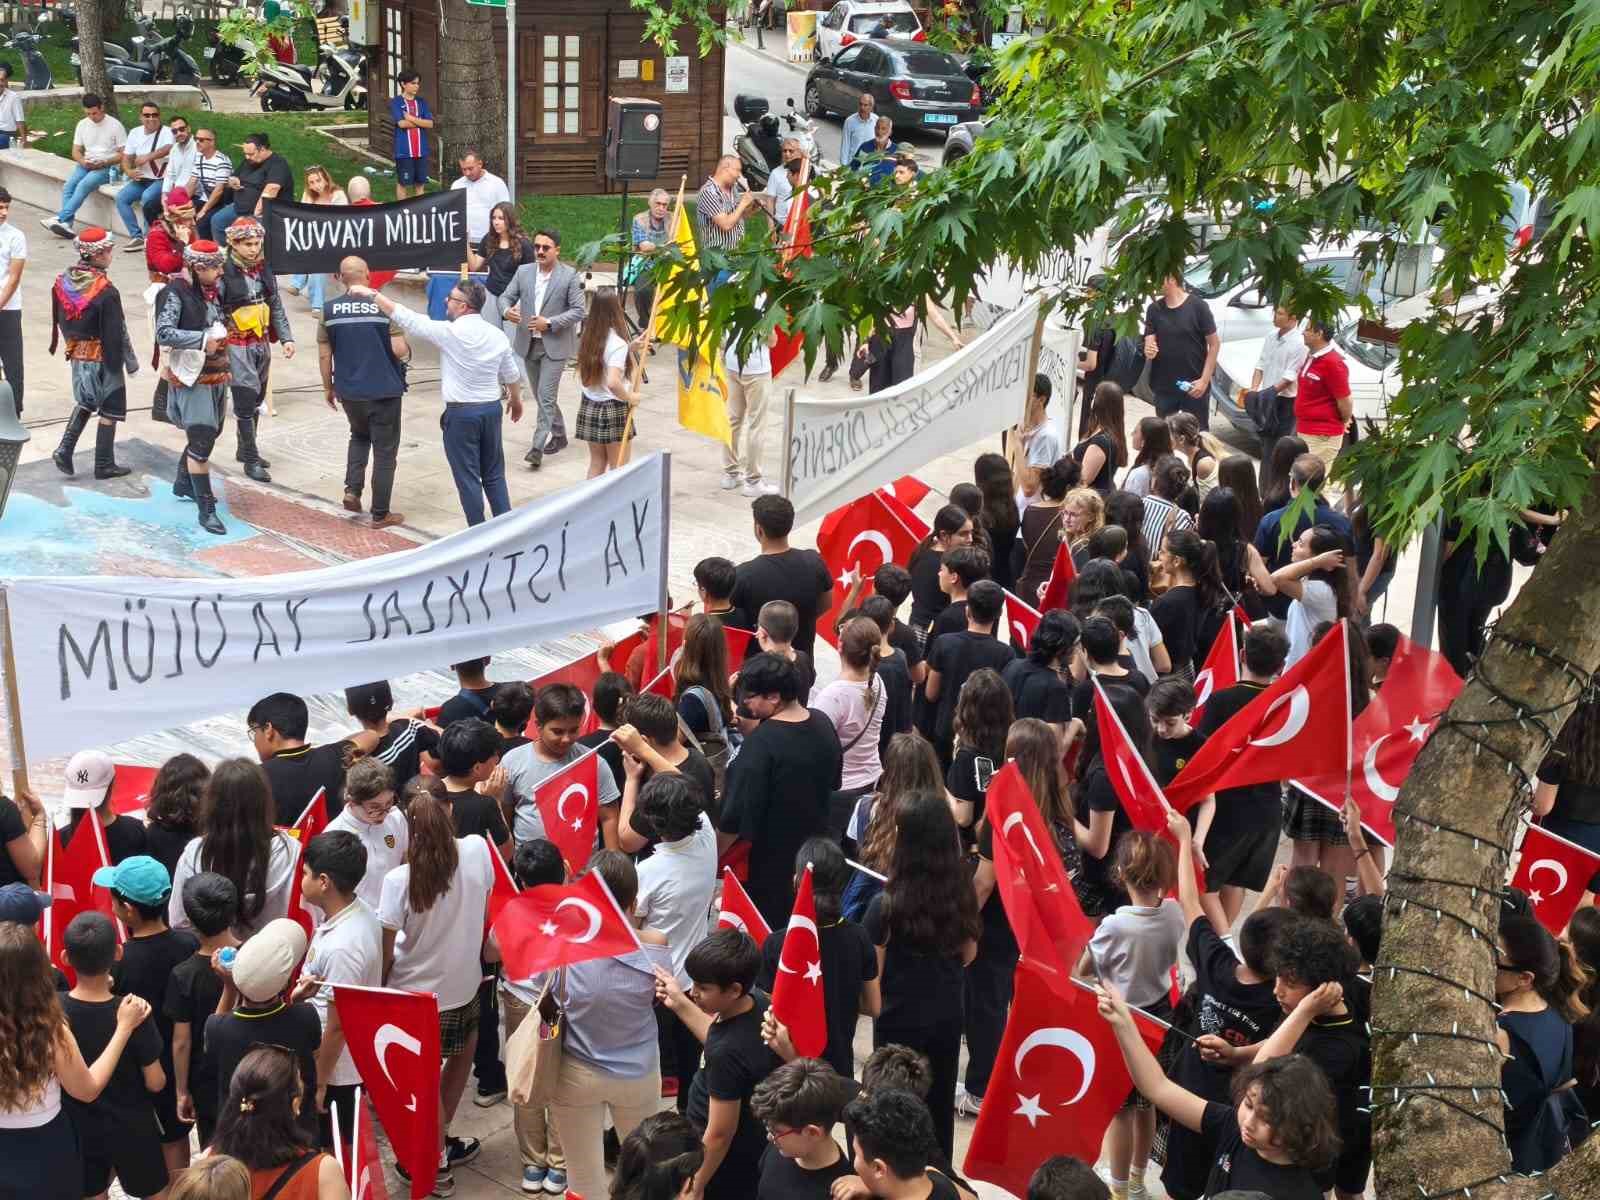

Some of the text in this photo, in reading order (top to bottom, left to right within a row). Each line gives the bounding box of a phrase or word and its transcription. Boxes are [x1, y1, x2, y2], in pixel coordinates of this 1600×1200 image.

[283, 206, 462, 252] KUVVAYI MİLLİYE
[332, 302, 379, 315] PRESS
